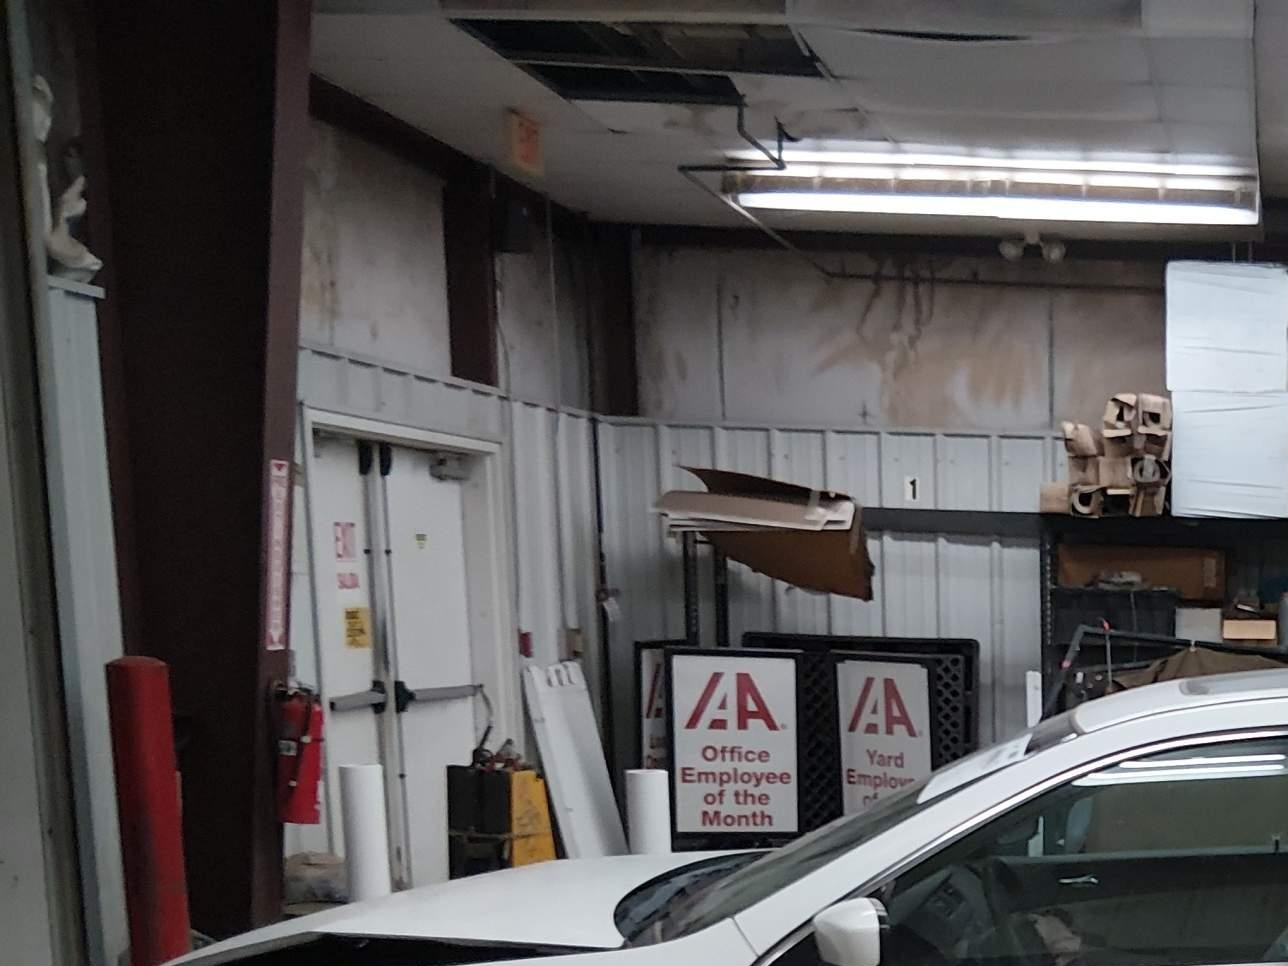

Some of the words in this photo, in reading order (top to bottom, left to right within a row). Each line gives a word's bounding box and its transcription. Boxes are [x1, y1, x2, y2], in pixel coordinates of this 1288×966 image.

[909, 478, 917, 500] 1
[701, 745, 770, 763] Office
[866, 749, 905, 768] Yard
[680, 766, 792, 788] Employee
[703, 789, 725, 806] of
[733, 789, 770, 806] the
[701, 810, 773, 827] Month
